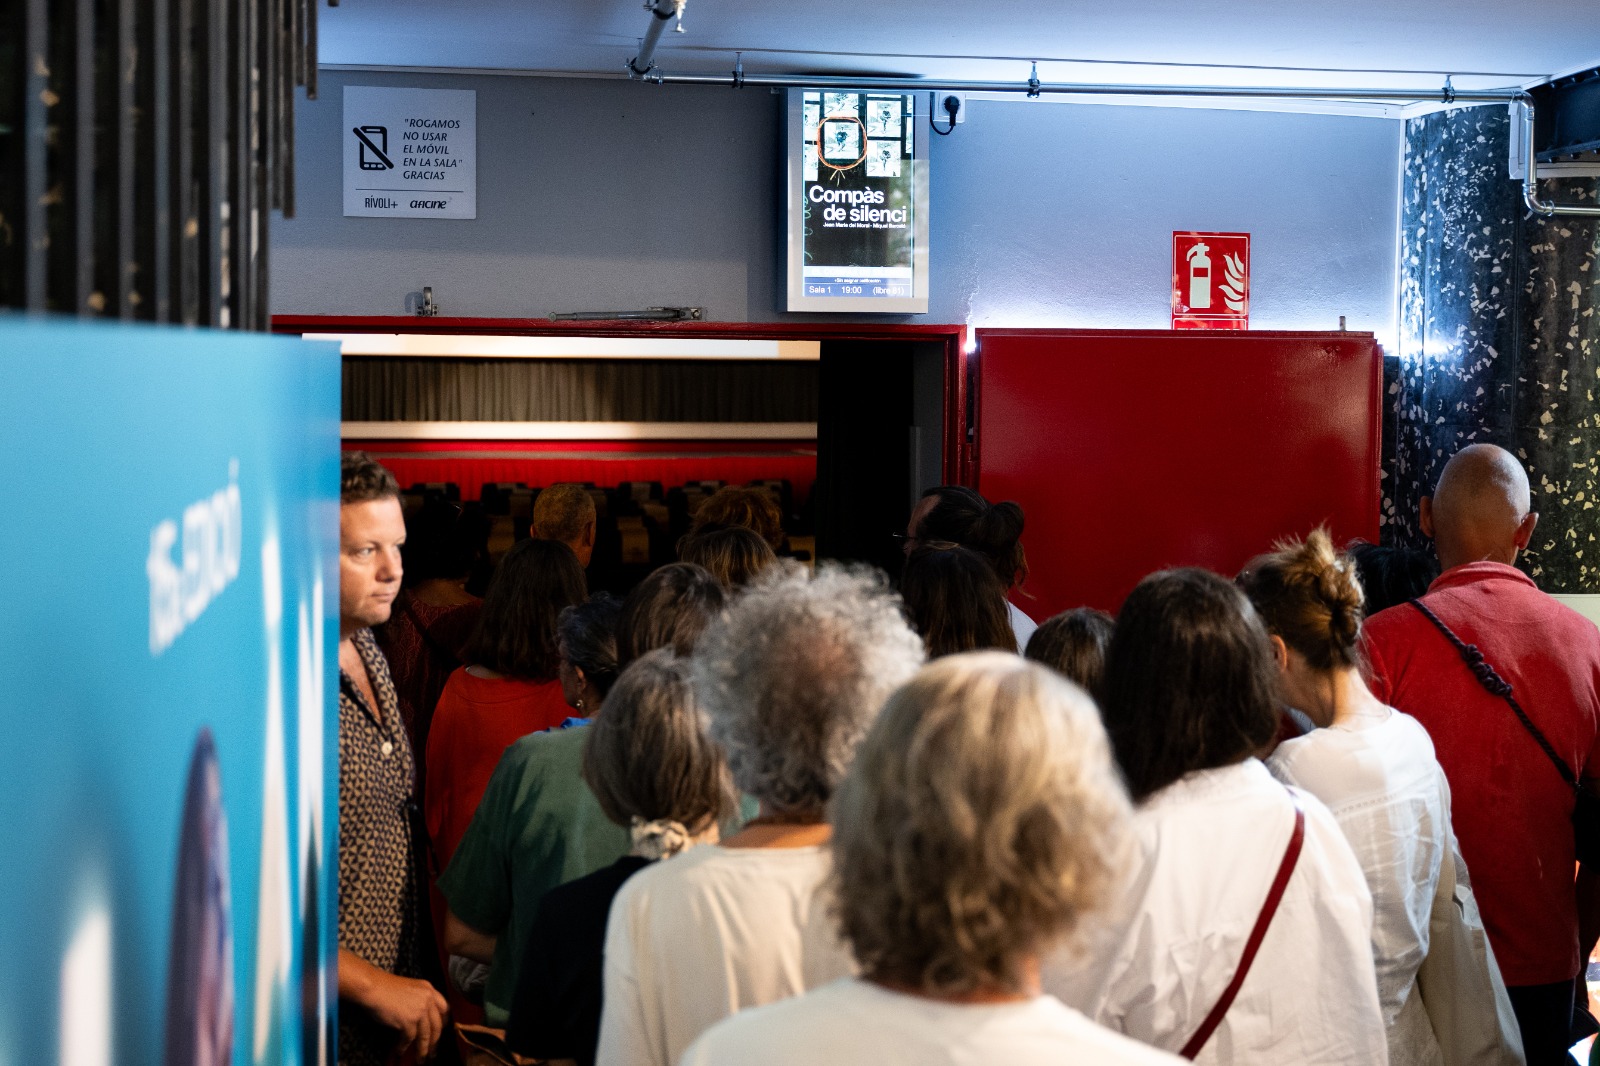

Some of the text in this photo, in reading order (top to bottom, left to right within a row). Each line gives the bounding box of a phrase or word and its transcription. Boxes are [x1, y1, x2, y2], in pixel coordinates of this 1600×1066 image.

[404, 118, 461, 129] "ROGAMOS
[403, 131, 448, 142] NO USAR
[403, 143, 450, 155] EL MÓVIL
[403, 157, 463, 168] EN LA SALA"
[403, 170, 446, 181] GRACIAS
[809, 184, 885, 208] Compàs
[409, 199, 447, 210] aficine
[823, 203, 907, 223] de silenci
[809, 285, 826, 294] Sala
[827, 286, 832, 294] 1
[841, 286, 862, 294] 19:00
